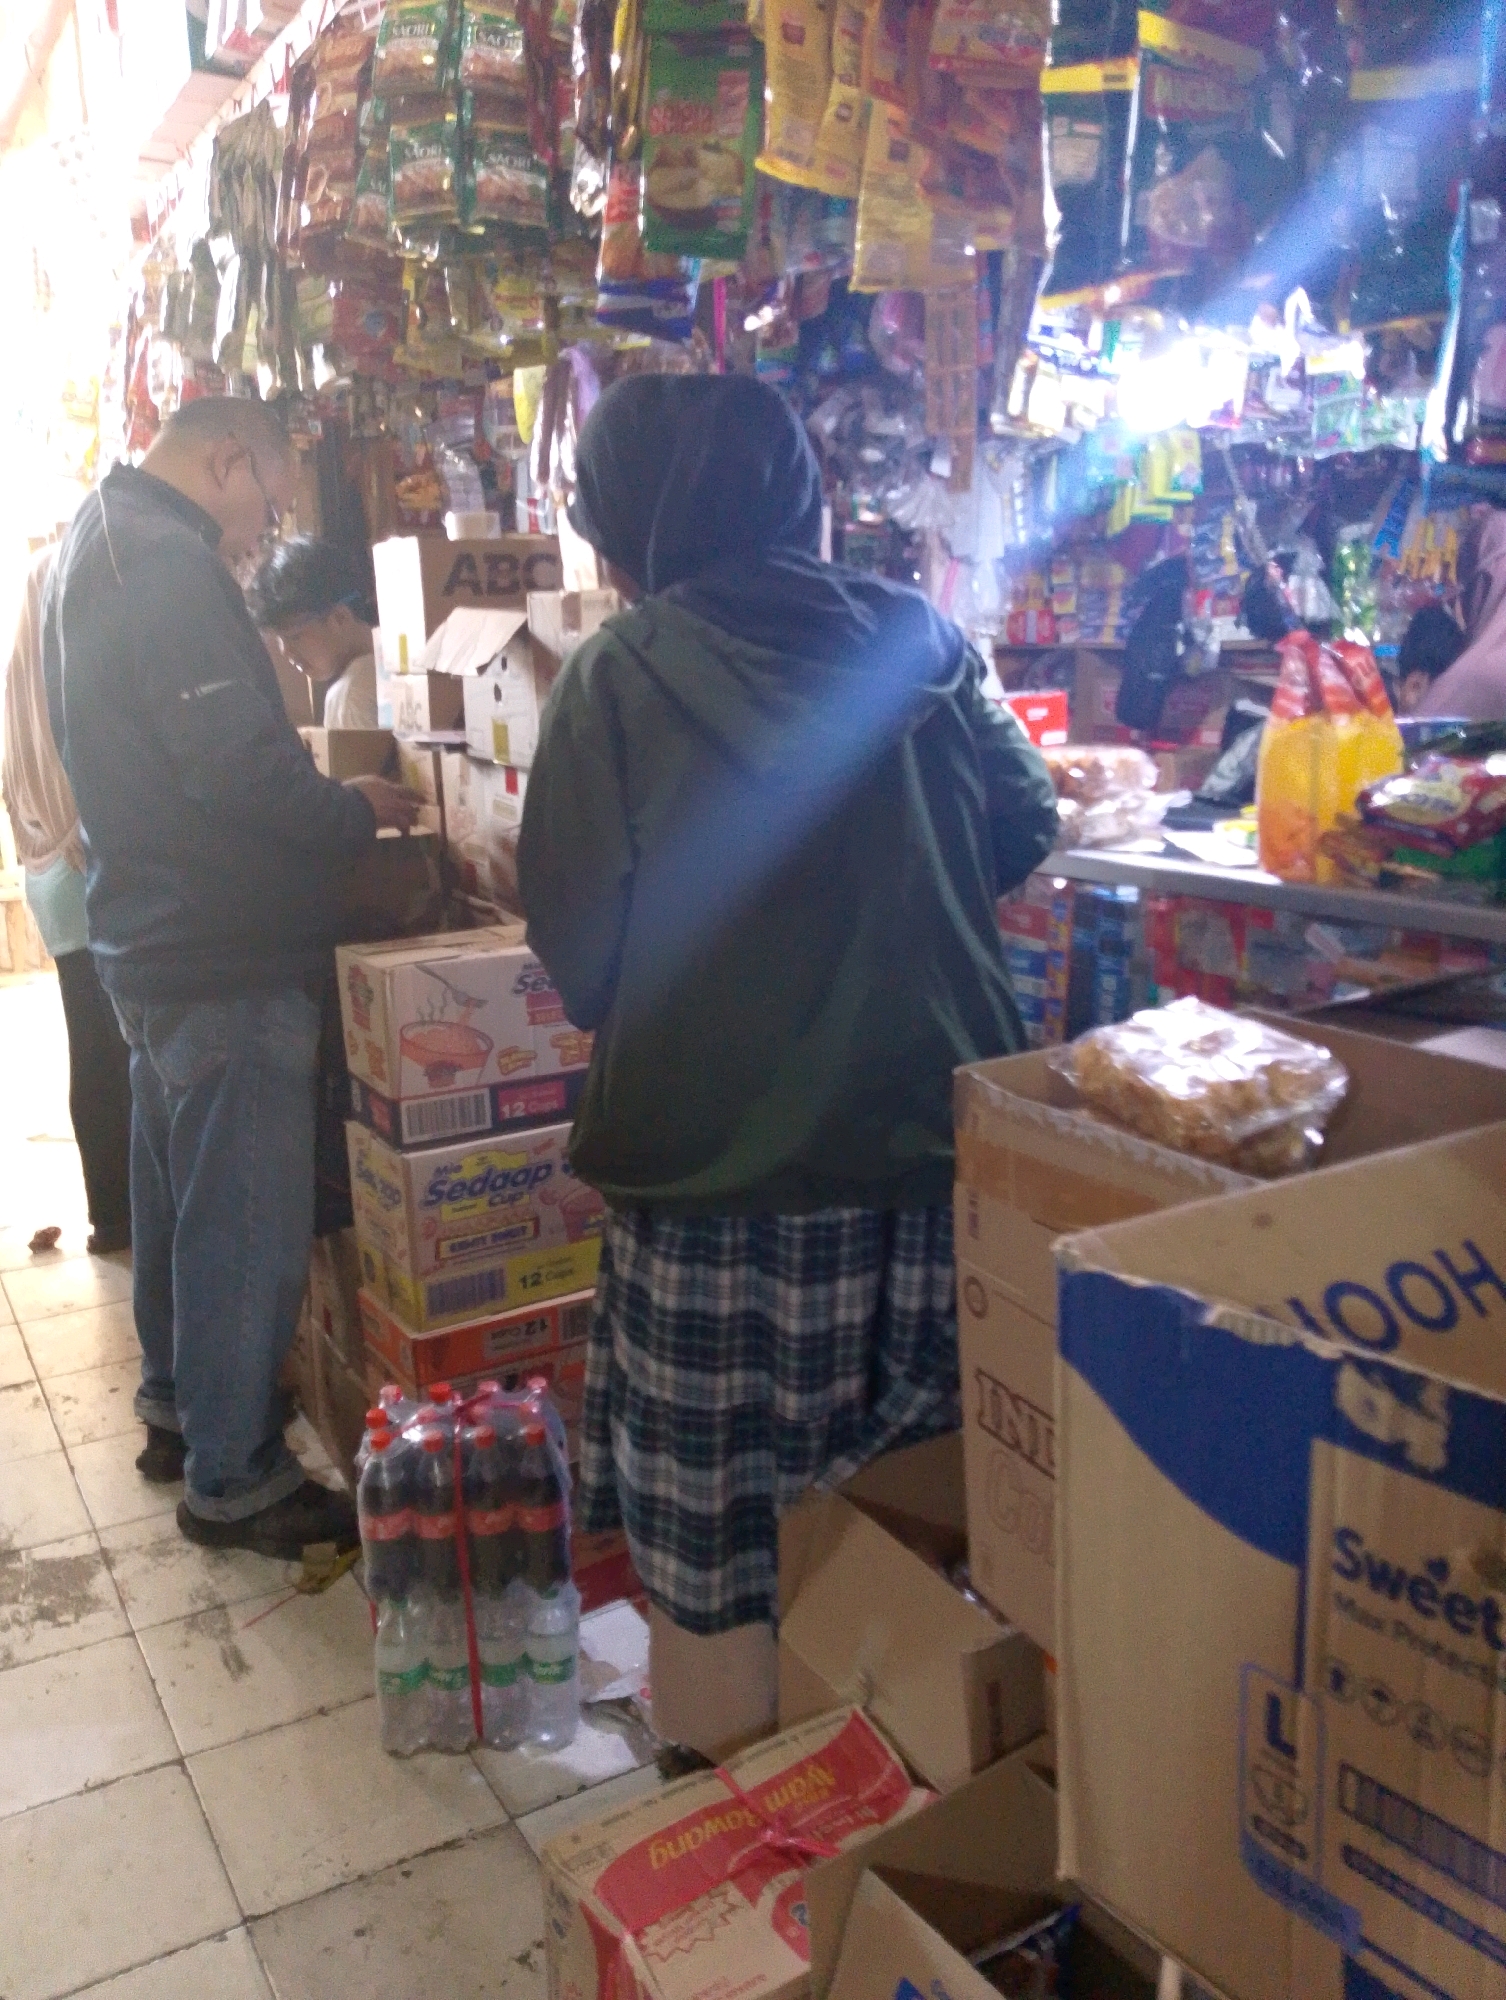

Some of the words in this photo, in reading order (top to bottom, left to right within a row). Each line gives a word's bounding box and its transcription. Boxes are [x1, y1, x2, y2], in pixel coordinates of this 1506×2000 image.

[441, 551, 560, 597] ABC
[501, 1102, 526, 1118] 12
[423, 1163, 554, 1208] Sedaap
[519, 1271, 543, 1290] 12
[1265, 1691, 1298, 1761] L
